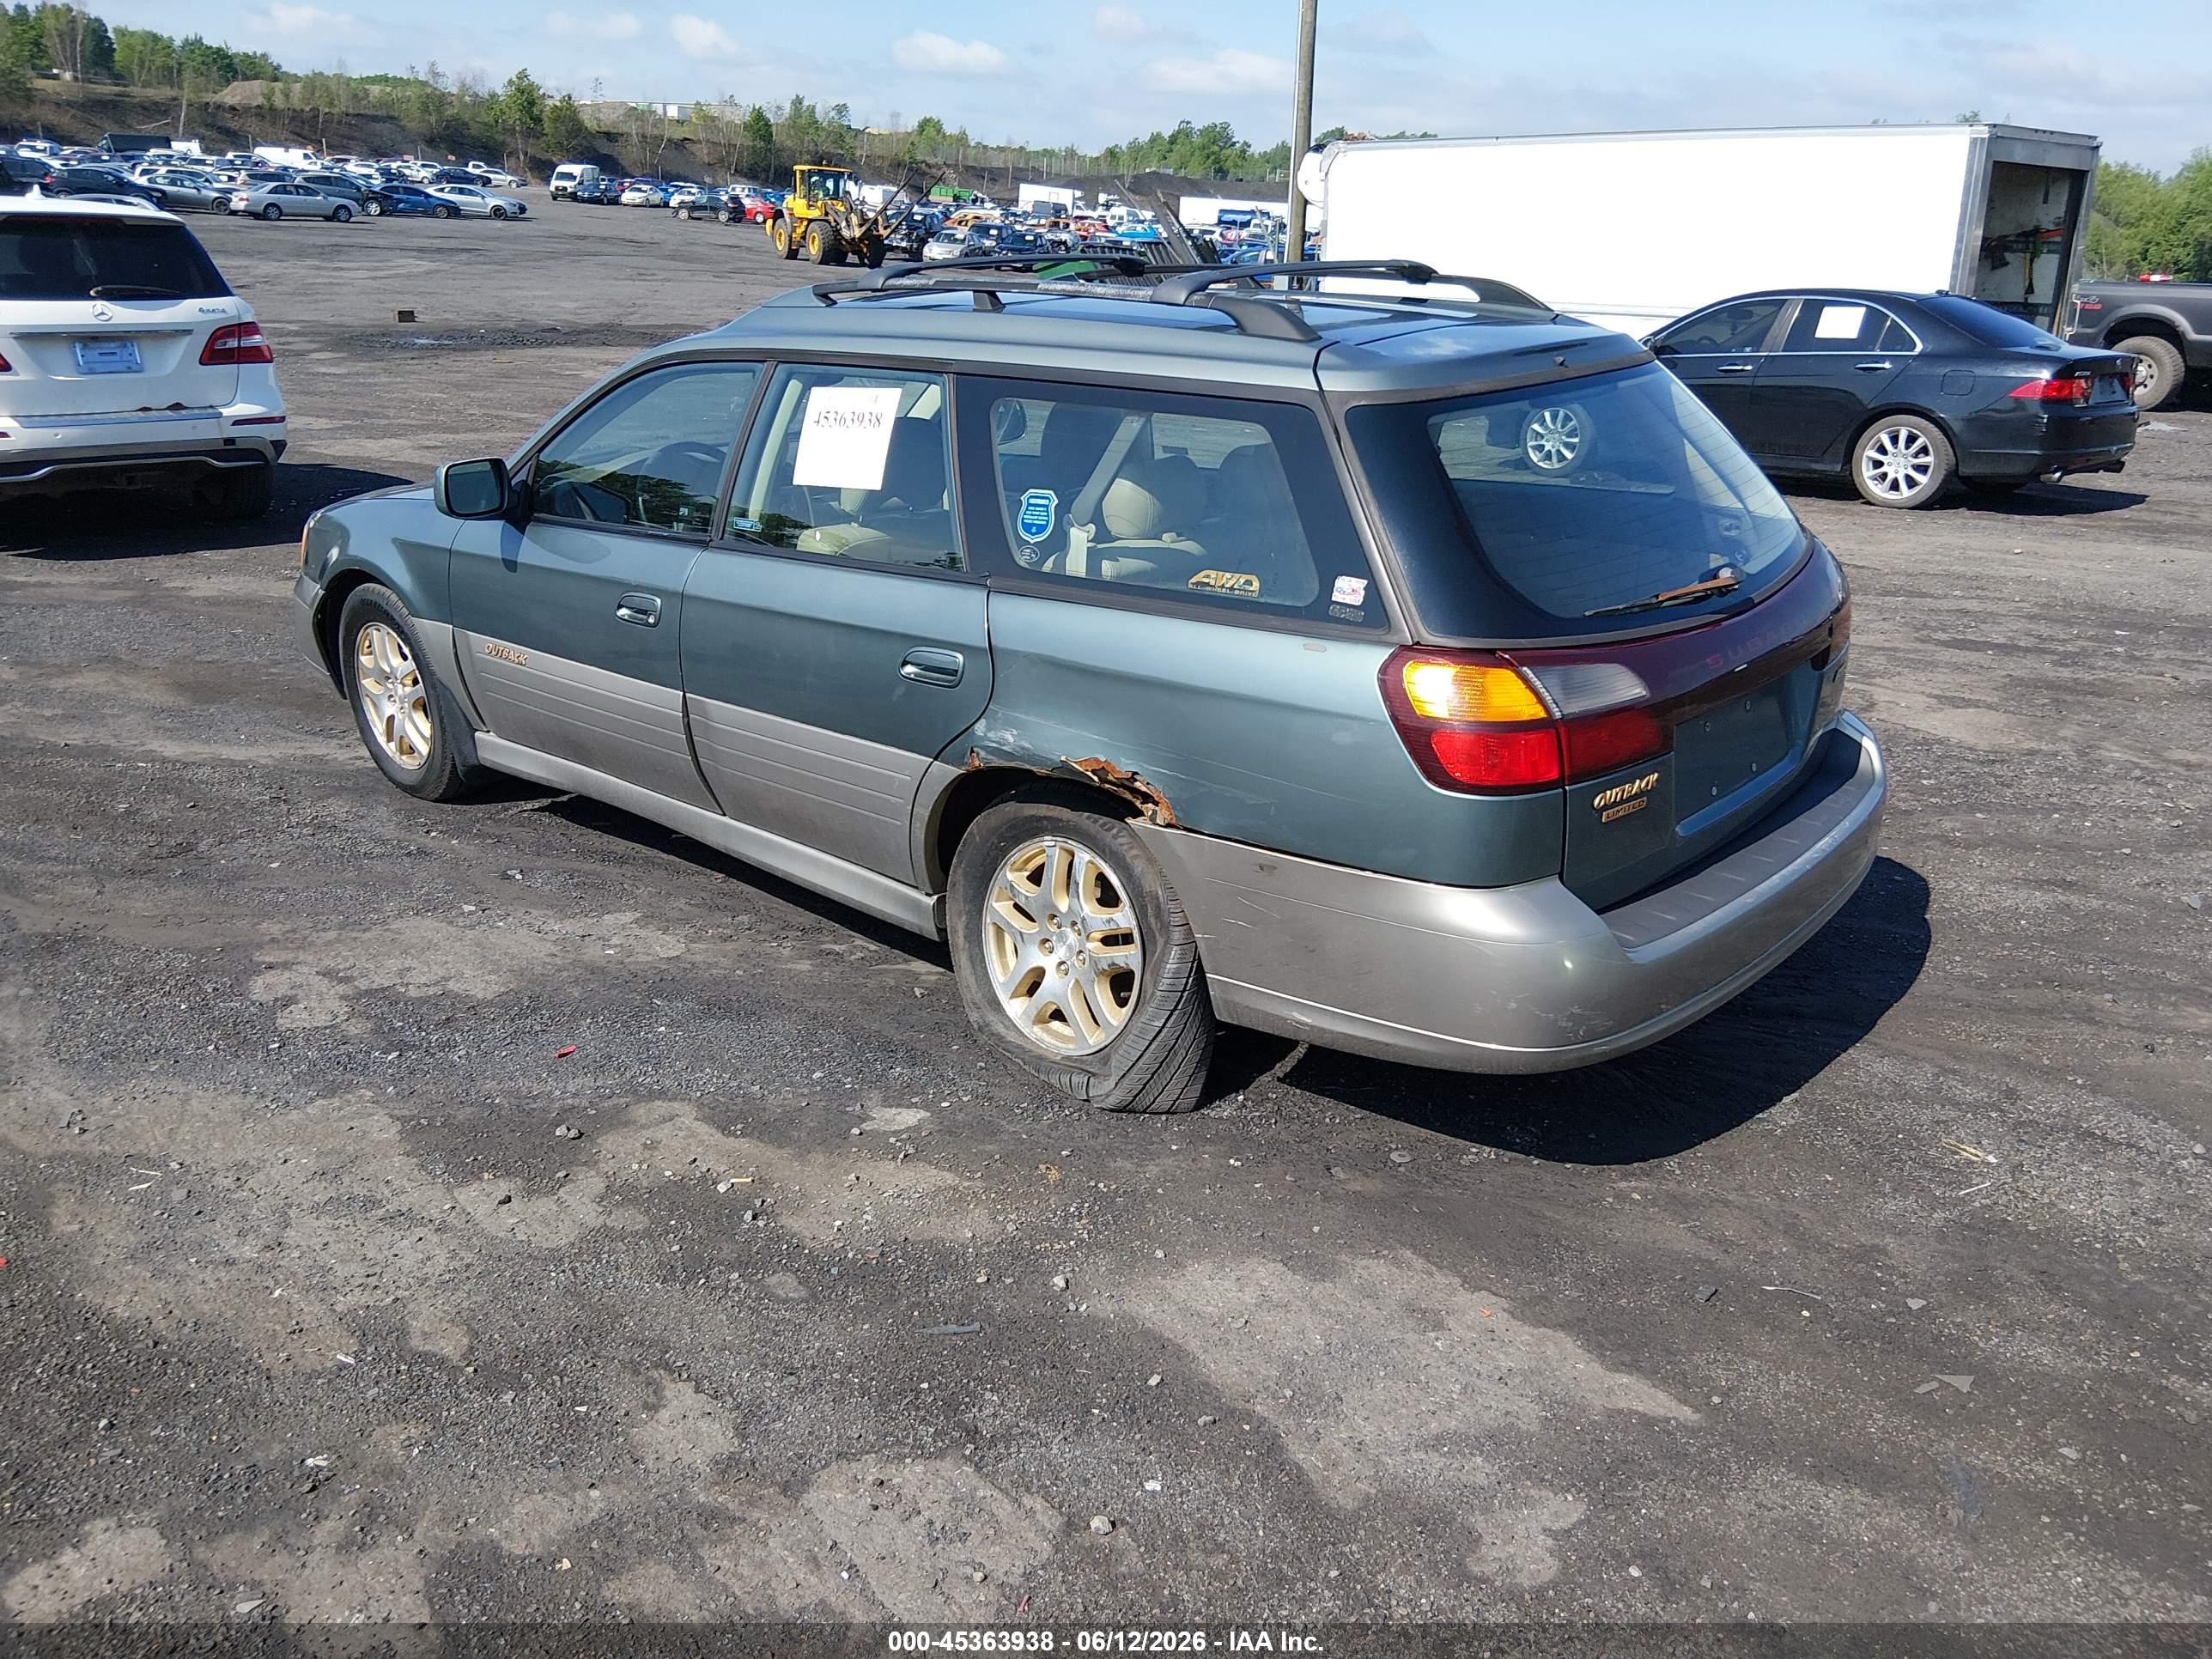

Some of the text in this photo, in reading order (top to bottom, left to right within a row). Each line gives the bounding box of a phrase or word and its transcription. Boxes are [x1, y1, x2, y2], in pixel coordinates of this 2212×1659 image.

[812, 410, 884, 429] 45363938
[1188, 569, 1260, 592] AWD
[485, 642, 529, 666] OUTBACK
[1593, 772, 1659, 810] OUTBACK
[1606, 799, 1645, 820] LIMITED
